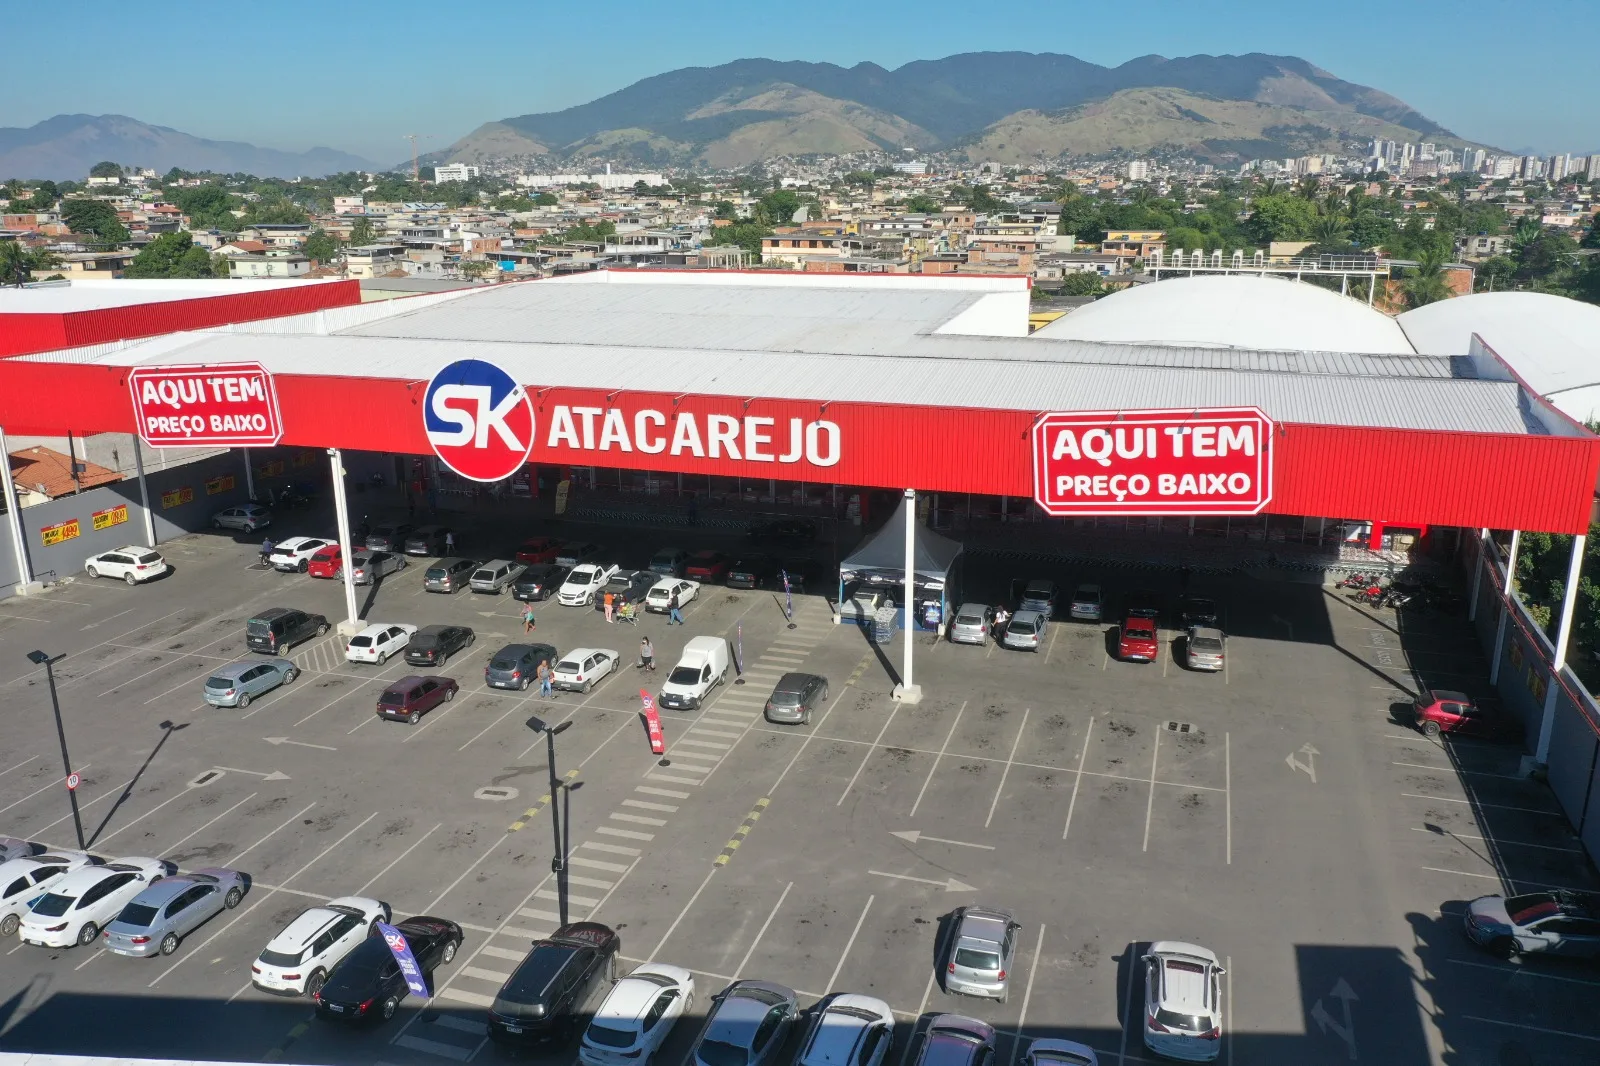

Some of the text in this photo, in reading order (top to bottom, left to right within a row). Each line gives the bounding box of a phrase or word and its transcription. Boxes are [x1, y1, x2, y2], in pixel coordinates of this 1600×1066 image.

[143, 377, 265, 410] AQUI TEM
[147, 414, 267, 438] PREÇO BAIXO
[428, 384, 525, 452] SK
[547, 406, 841, 467] ATACAREJO
[1052, 425, 1255, 467] AQUI TEM
[1056, 473, 1251, 502] PREÇO BAIXO
[643, 699, 654, 709] SK
[69, 776, 76, 785] 10
[385, 934, 404, 947] SK
